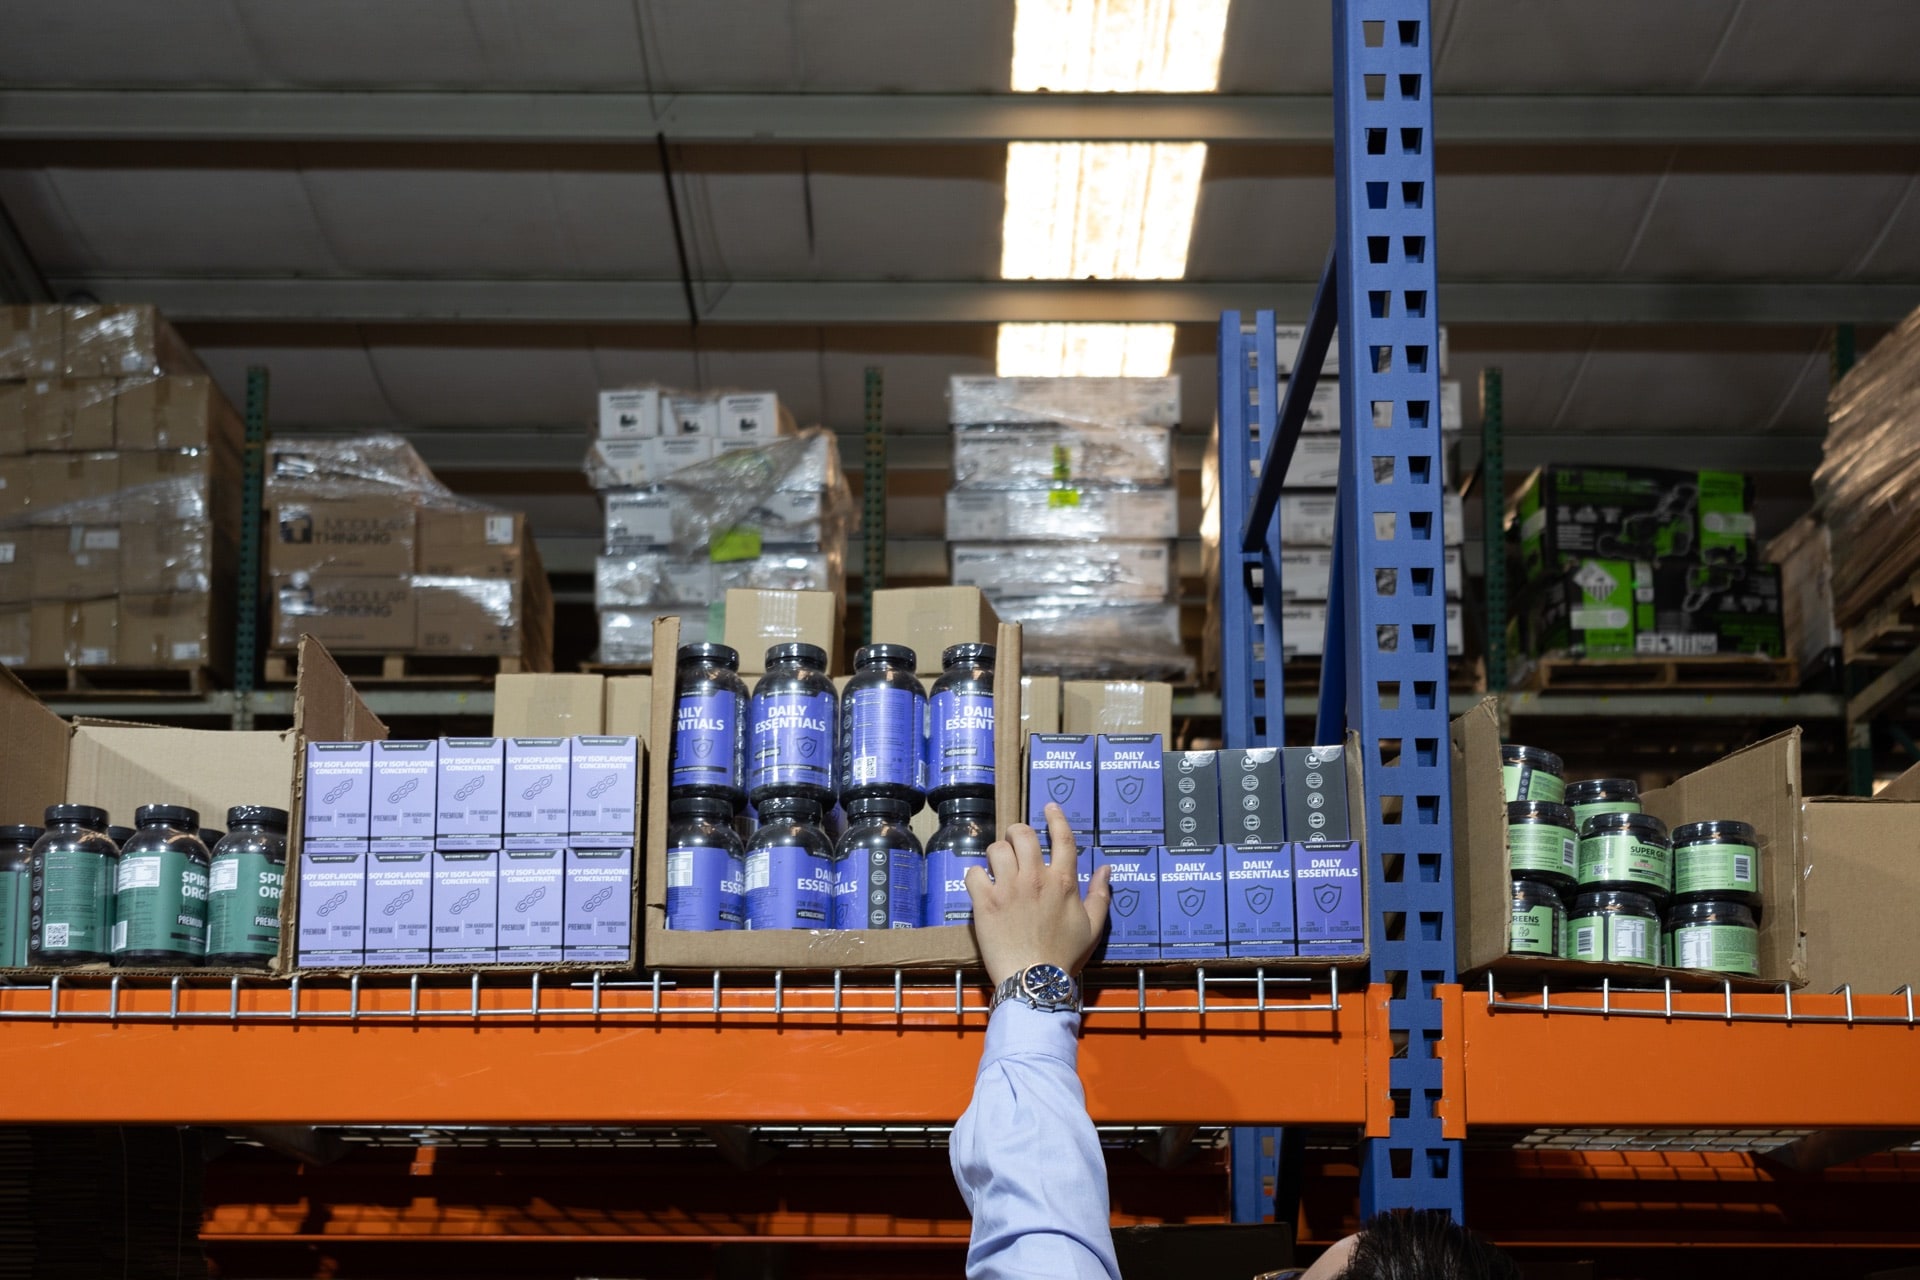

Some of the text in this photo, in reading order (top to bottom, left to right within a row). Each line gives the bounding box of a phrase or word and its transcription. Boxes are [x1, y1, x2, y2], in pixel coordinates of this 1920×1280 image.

[313, 531, 392, 545] THINKING
[325, 590, 406, 603] MODULAR
[326, 603, 393, 617] HINKING
[678, 706, 703, 719] AILY
[768, 705, 807, 718] DAILY
[963, 706, 995, 719] DAIL
[677, 719, 725, 731] NTIALS
[755, 717, 826, 734] ESSENTIALS
[945, 717, 995, 731] ESSENT
[1046, 751, 1076, 760] DAILY
[1114, 751, 1144, 760] DAILY
[309, 761, 324, 769] SOY
[390, 760, 435, 768] ISOFLAVONE
[1033, 760, 1092, 770] ESSENTIALS
[1101, 760, 1160, 770] ESSENTIALS
[440, 812, 465, 820] PREMIUM
[1630, 846, 1655, 856] SUPER
[1111, 863, 1140, 872] DAILY
[1175, 863, 1205, 872] DAILY
[1243, 860, 1273, 869] DAILY
[1311, 859, 1341, 868] DAILY
[369, 872, 384, 880] SOY
[501, 869, 515, 877] SOY
[583, 868, 629, 876] ISOFLAVONE
[1109, 872, 1156, 882] SENTIALS
[1162, 872, 1222, 882] ESSENTIALS
[1229, 869, 1290, 879] ESSENTIALS
[1298, 868, 1358, 878] ESSENTIALS
[182, 871, 208, 888] SPIR
[1512, 915, 1540, 923] REENS
[303, 928, 327, 936] PREMIUM
